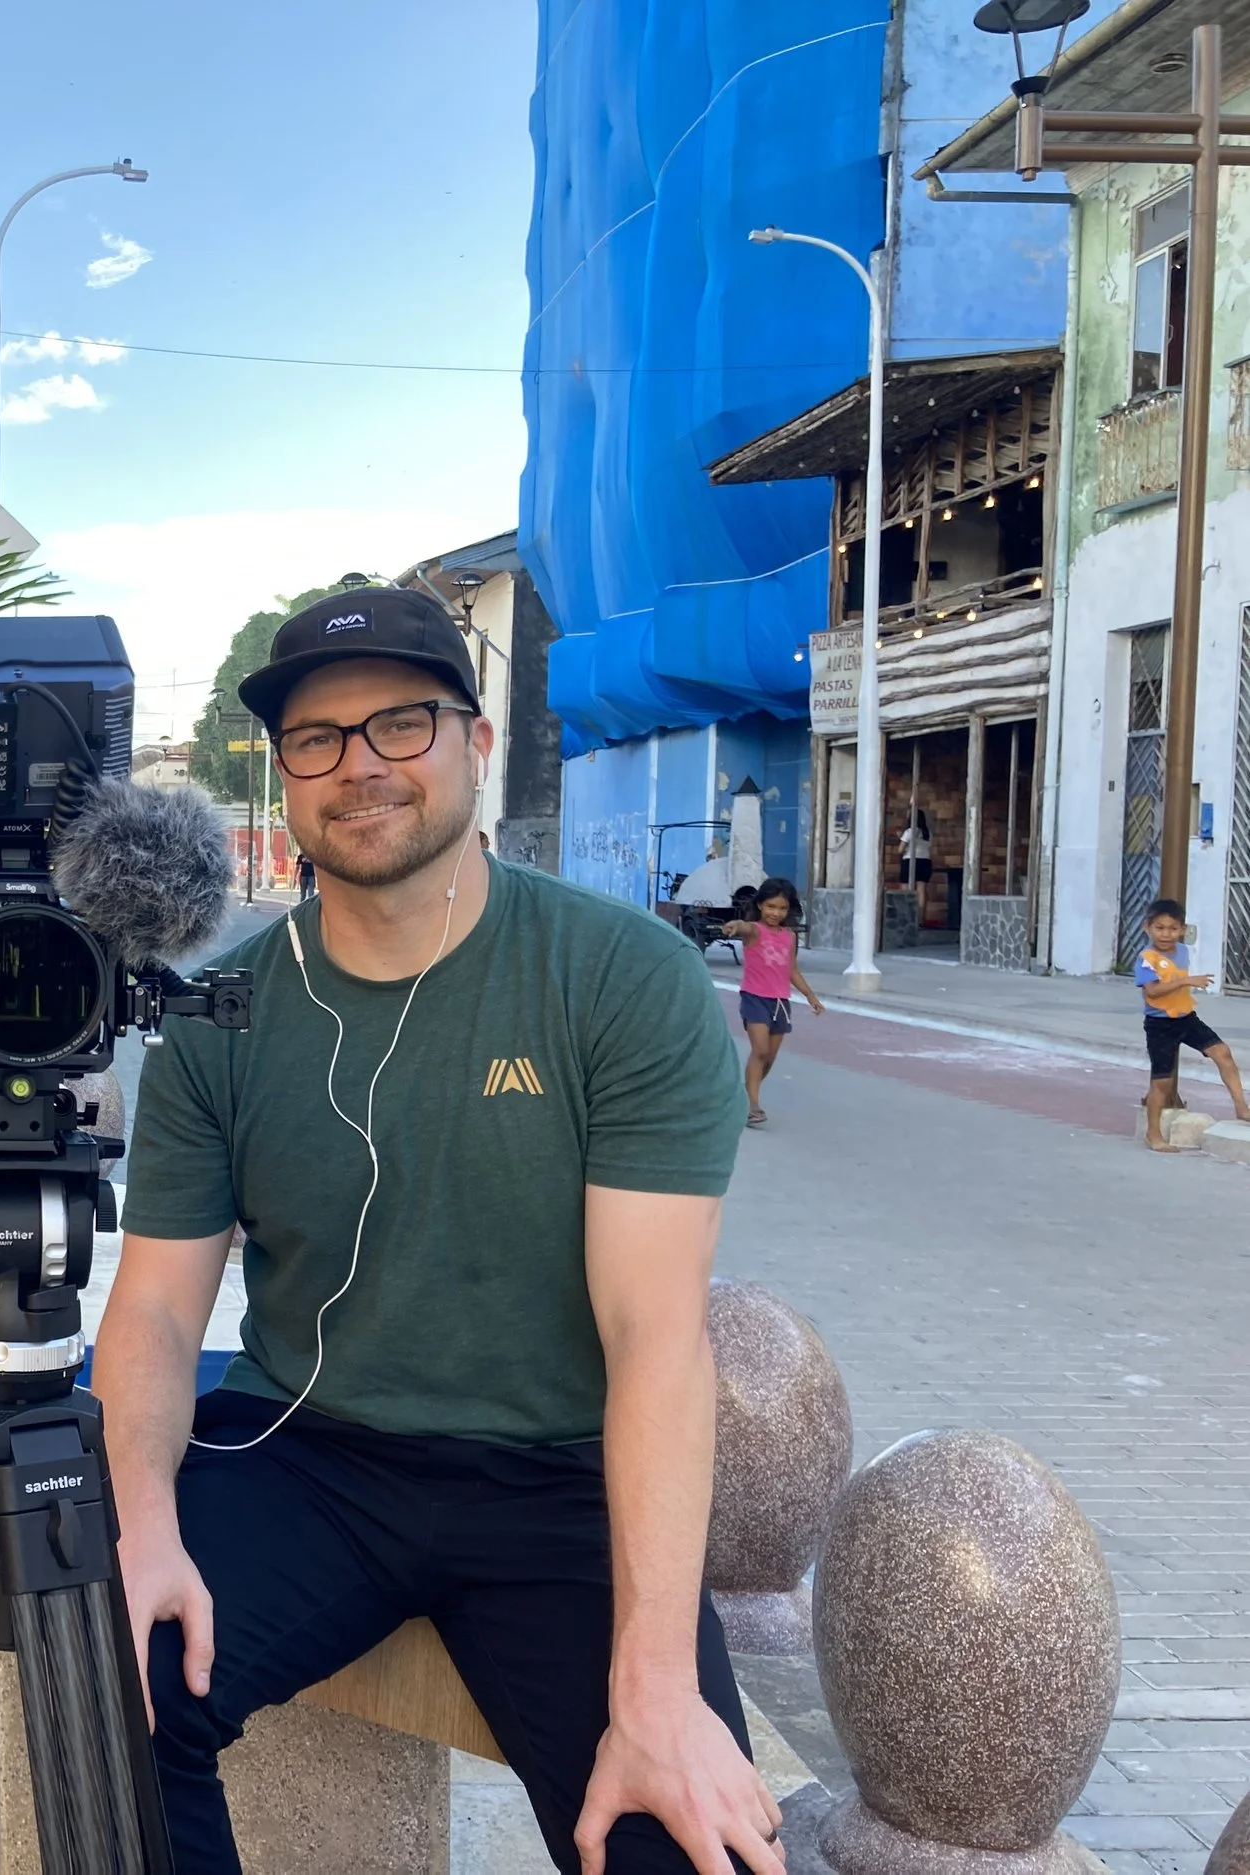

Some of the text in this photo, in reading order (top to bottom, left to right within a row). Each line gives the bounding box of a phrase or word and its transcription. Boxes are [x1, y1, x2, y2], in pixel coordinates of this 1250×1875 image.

[326, 614, 365, 630] AVA
[812, 633, 832, 652] PIZZA
[826, 656, 832, 672] A
[833, 655, 842, 672] LA
[812, 679, 853, 693] PASTAS
[813, 697, 859, 711] PARRILL
[25, 1476, 83, 1493] sachtler
